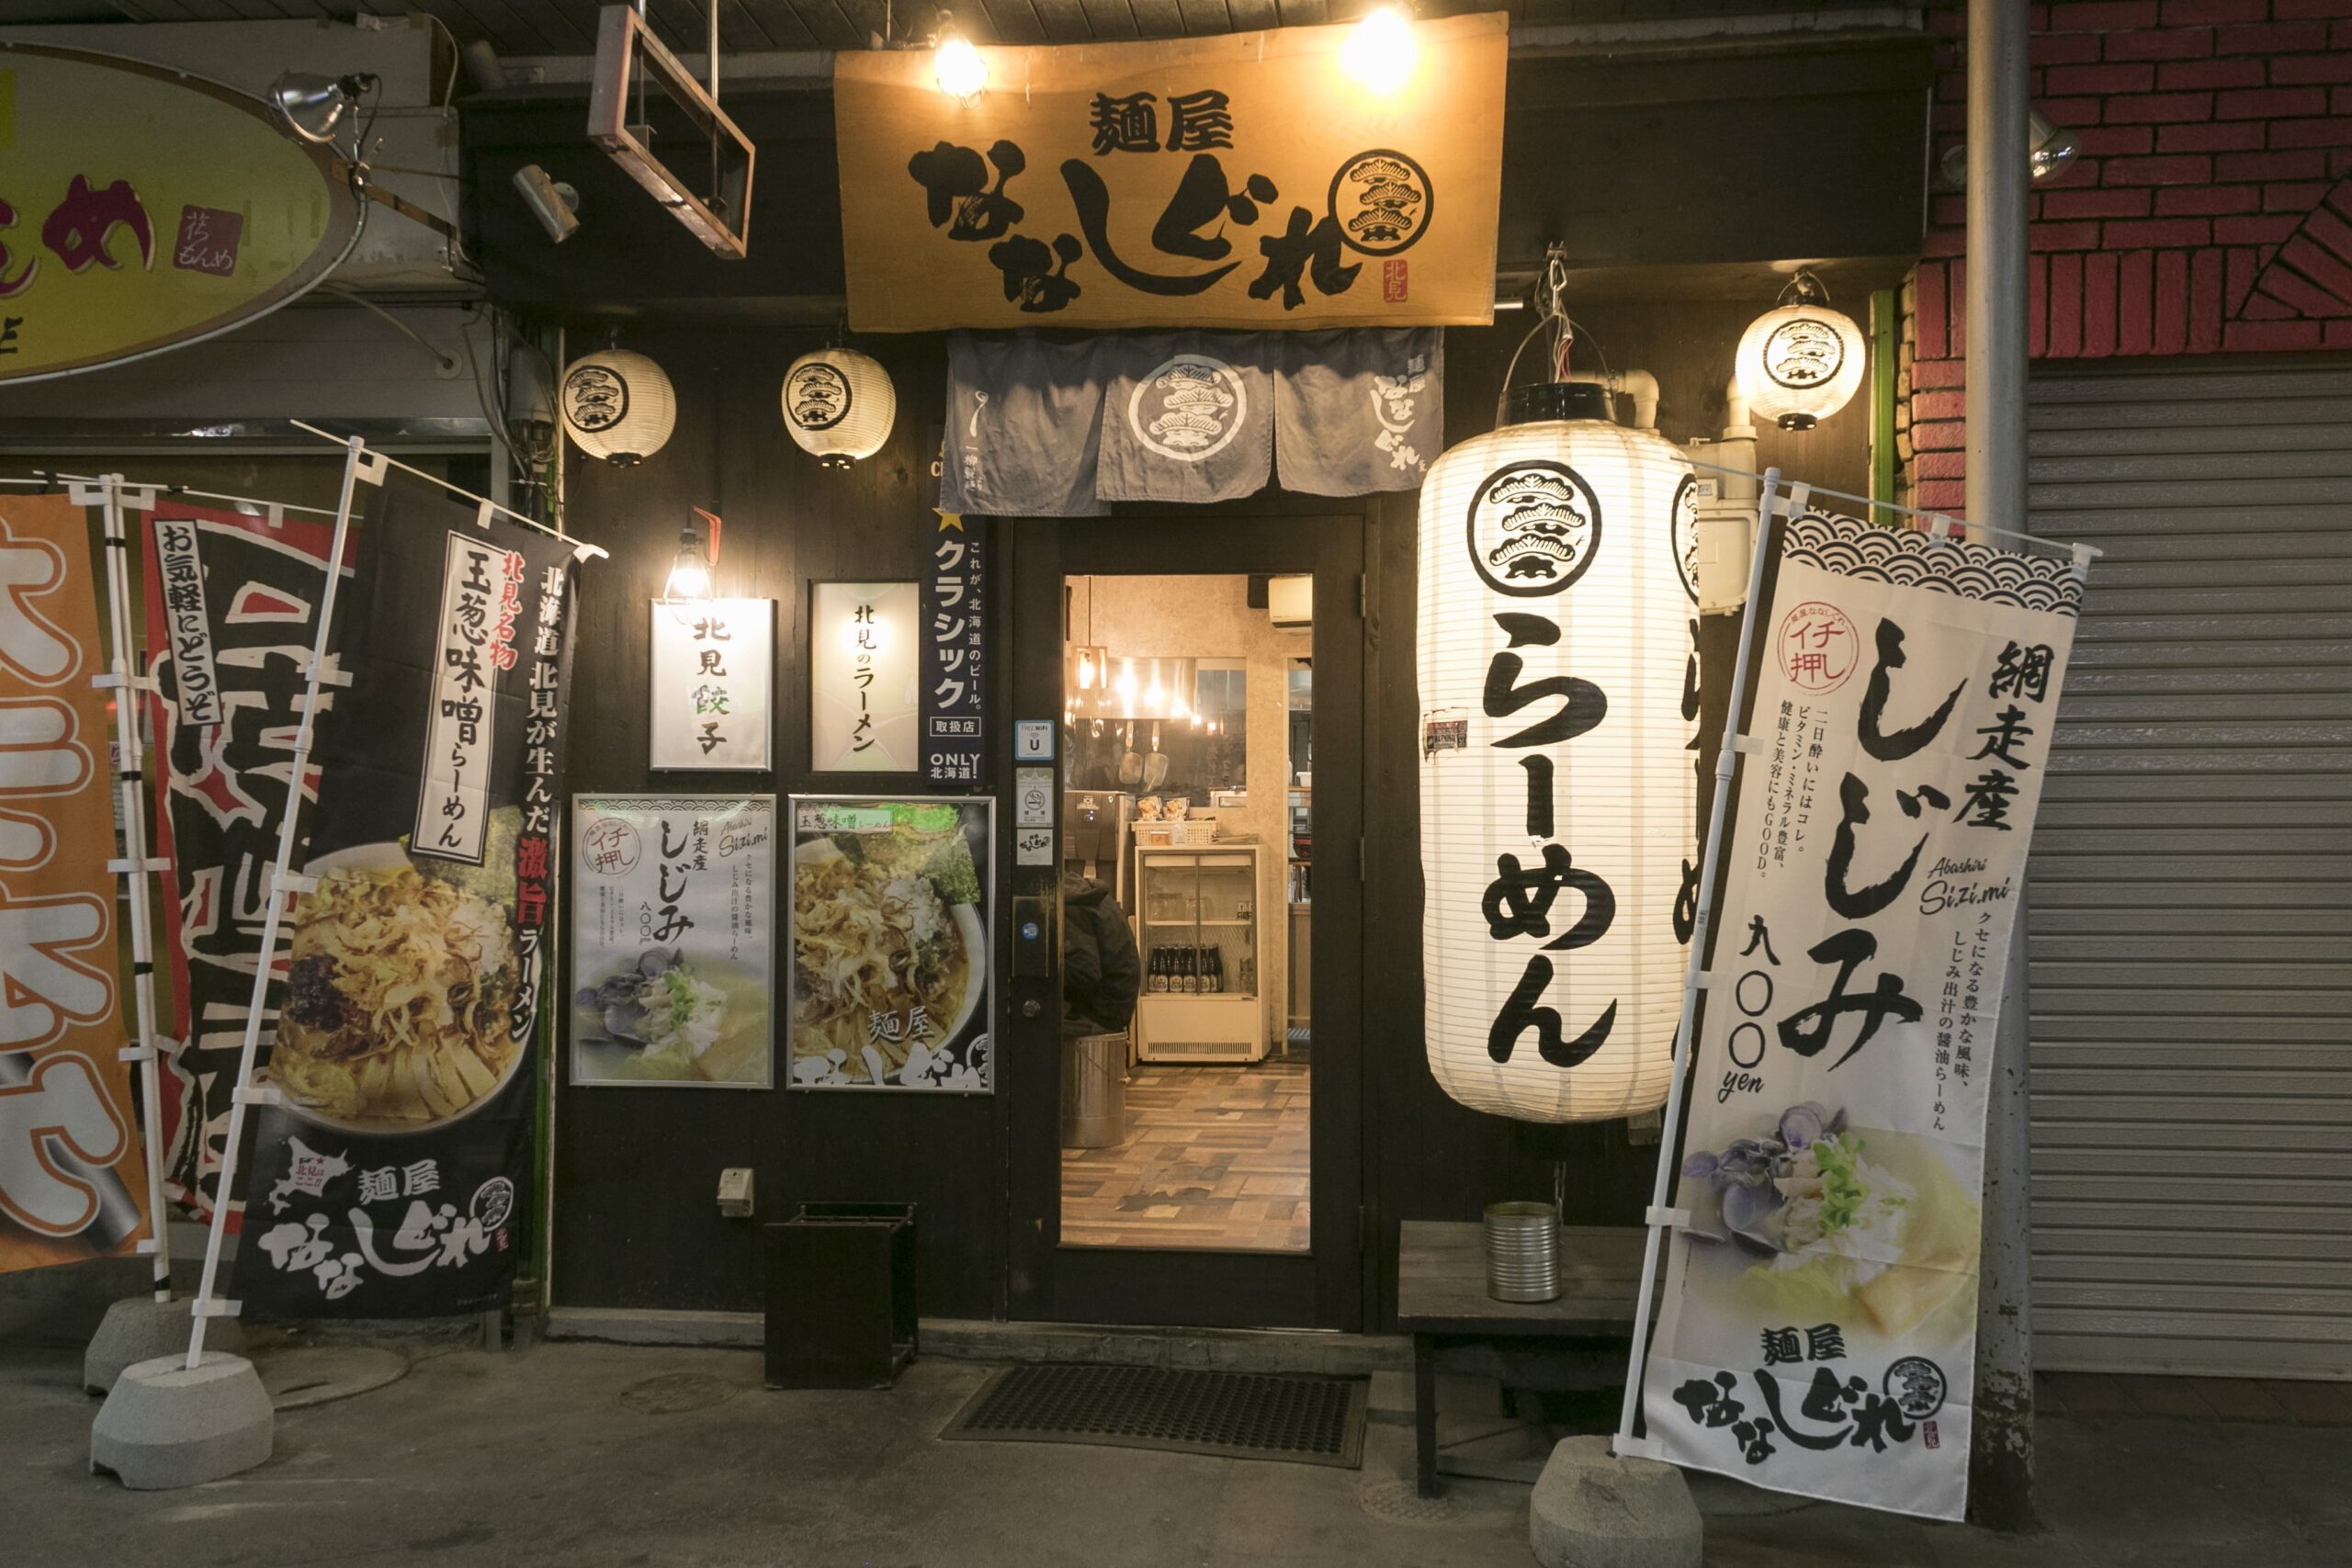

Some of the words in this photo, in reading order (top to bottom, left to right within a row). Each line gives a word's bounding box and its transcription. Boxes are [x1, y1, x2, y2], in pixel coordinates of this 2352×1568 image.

[1090, 89, 1234, 156] 麺屋
[908, 140, 1364, 313] ななしぐれ
[1386, 260, 1407, 302] 北見
[162, 525, 213, 722] お気軽にどうぞ
[490, 550, 526, 671] 北見名物
[933, 540, 966, 709] クラシック
[968, 541, 982, 710] これが、北海道のビール。
[1790, 621, 1846, 649] イチ
[438, 550, 492, 848] 玉葱味噌らーめん
[692, 615, 732, 756] 北見餃子
[853, 604, 877, 752] 北見のラーメン
[1790, 652, 1846, 683] 押し
[931, 753, 980, 766] ONLY
[935, 720, 976, 733] 取扱店
[1030, 739, 1040, 750] U
[1795, 709, 1828, 852] 二日酔いにはコレ。
[1952, 640, 2054, 830] 網走産
[653, 819, 695, 944] しじみ
[693, 820, 708, 871] 網走産
[1482, 612, 1617, 1068] らーめん
[1777, 617, 1969, 1072] しじみ
[1928, 857, 1987, 878] Abashiri
[868, 1005, 936, 1043] 麺屋
[1933, 931, 1967, 1131] しじみ出汁の醤油らーめん
[1954, 911, 1992, 1087] クセになる豊かな風味、
[1717, 1070, 1764, 1103] yen
[357, 1159, 441, 1205] 麺屋
[258, 1200, 492, 1300] ななしぐれ
[1760, 1322, 1848, 1366] 麺屋
[1672, 1367, 1917, 1465] ななしぐれ
